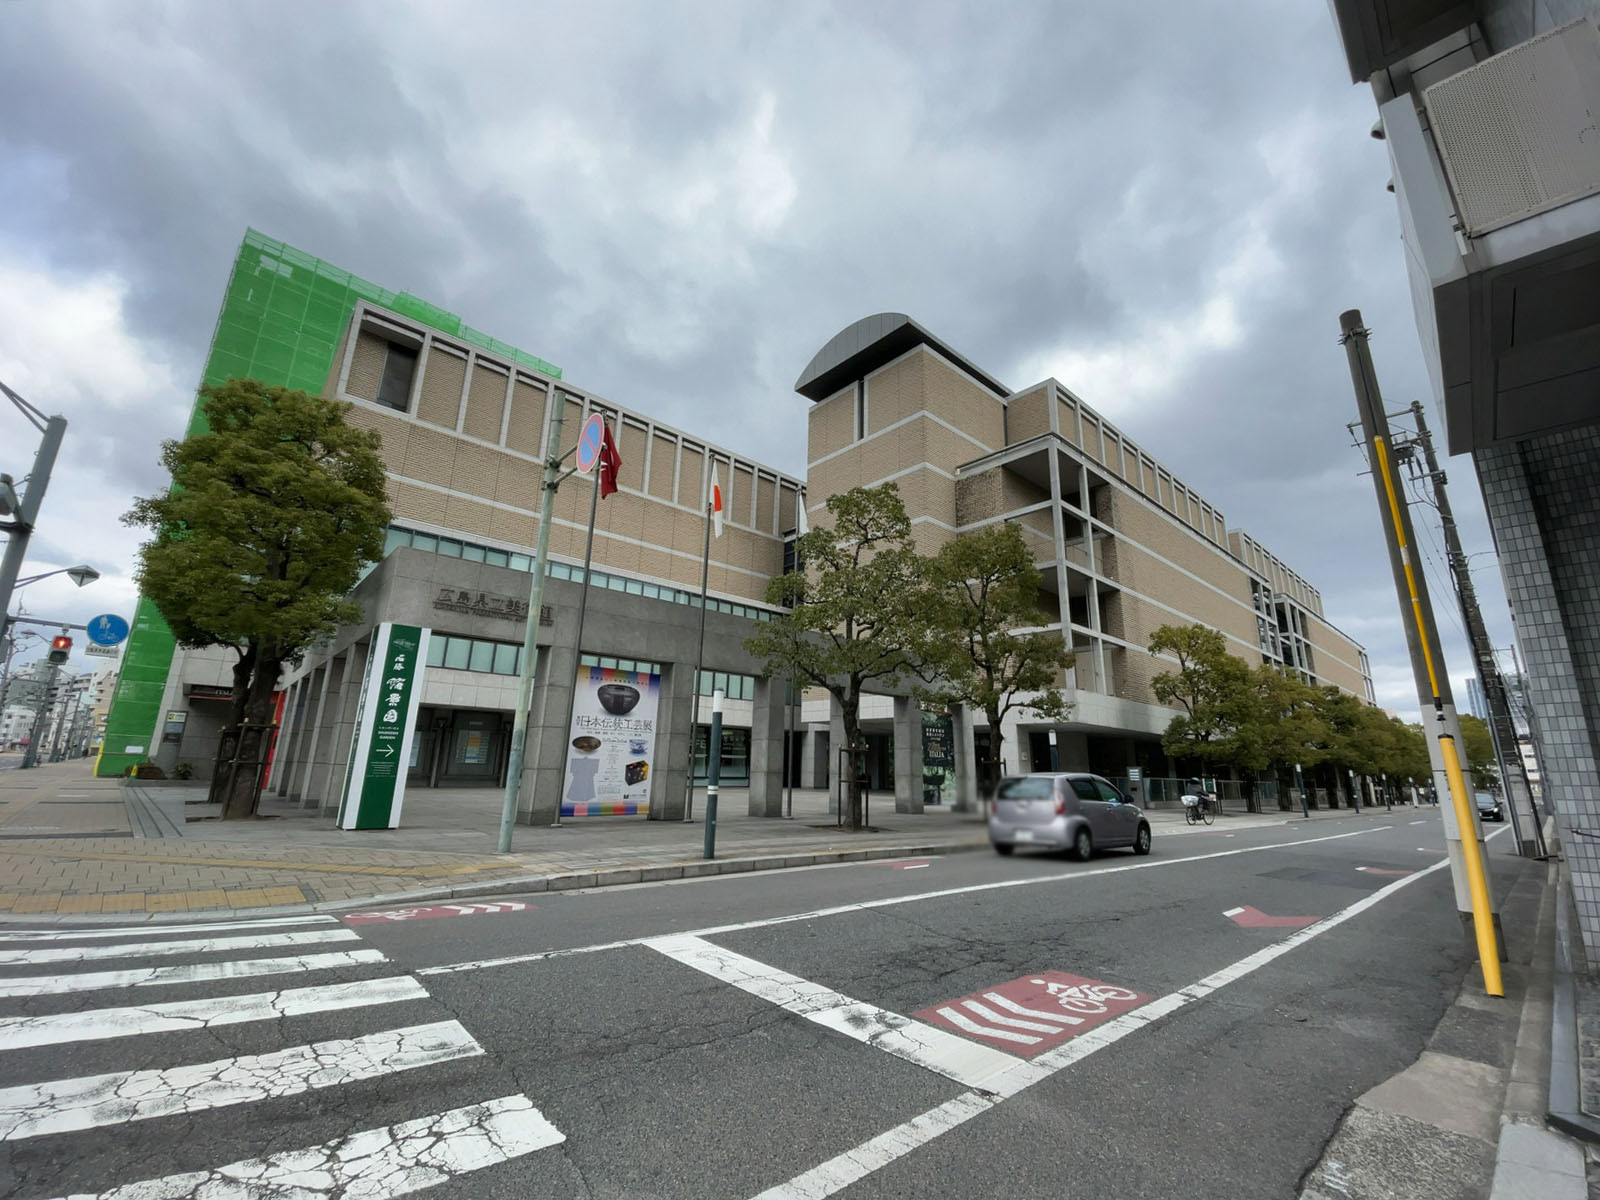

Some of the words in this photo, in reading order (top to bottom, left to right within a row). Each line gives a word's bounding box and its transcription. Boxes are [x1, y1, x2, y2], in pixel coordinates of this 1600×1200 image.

[580, 715, 653, 732] 日本伝統工芸展
